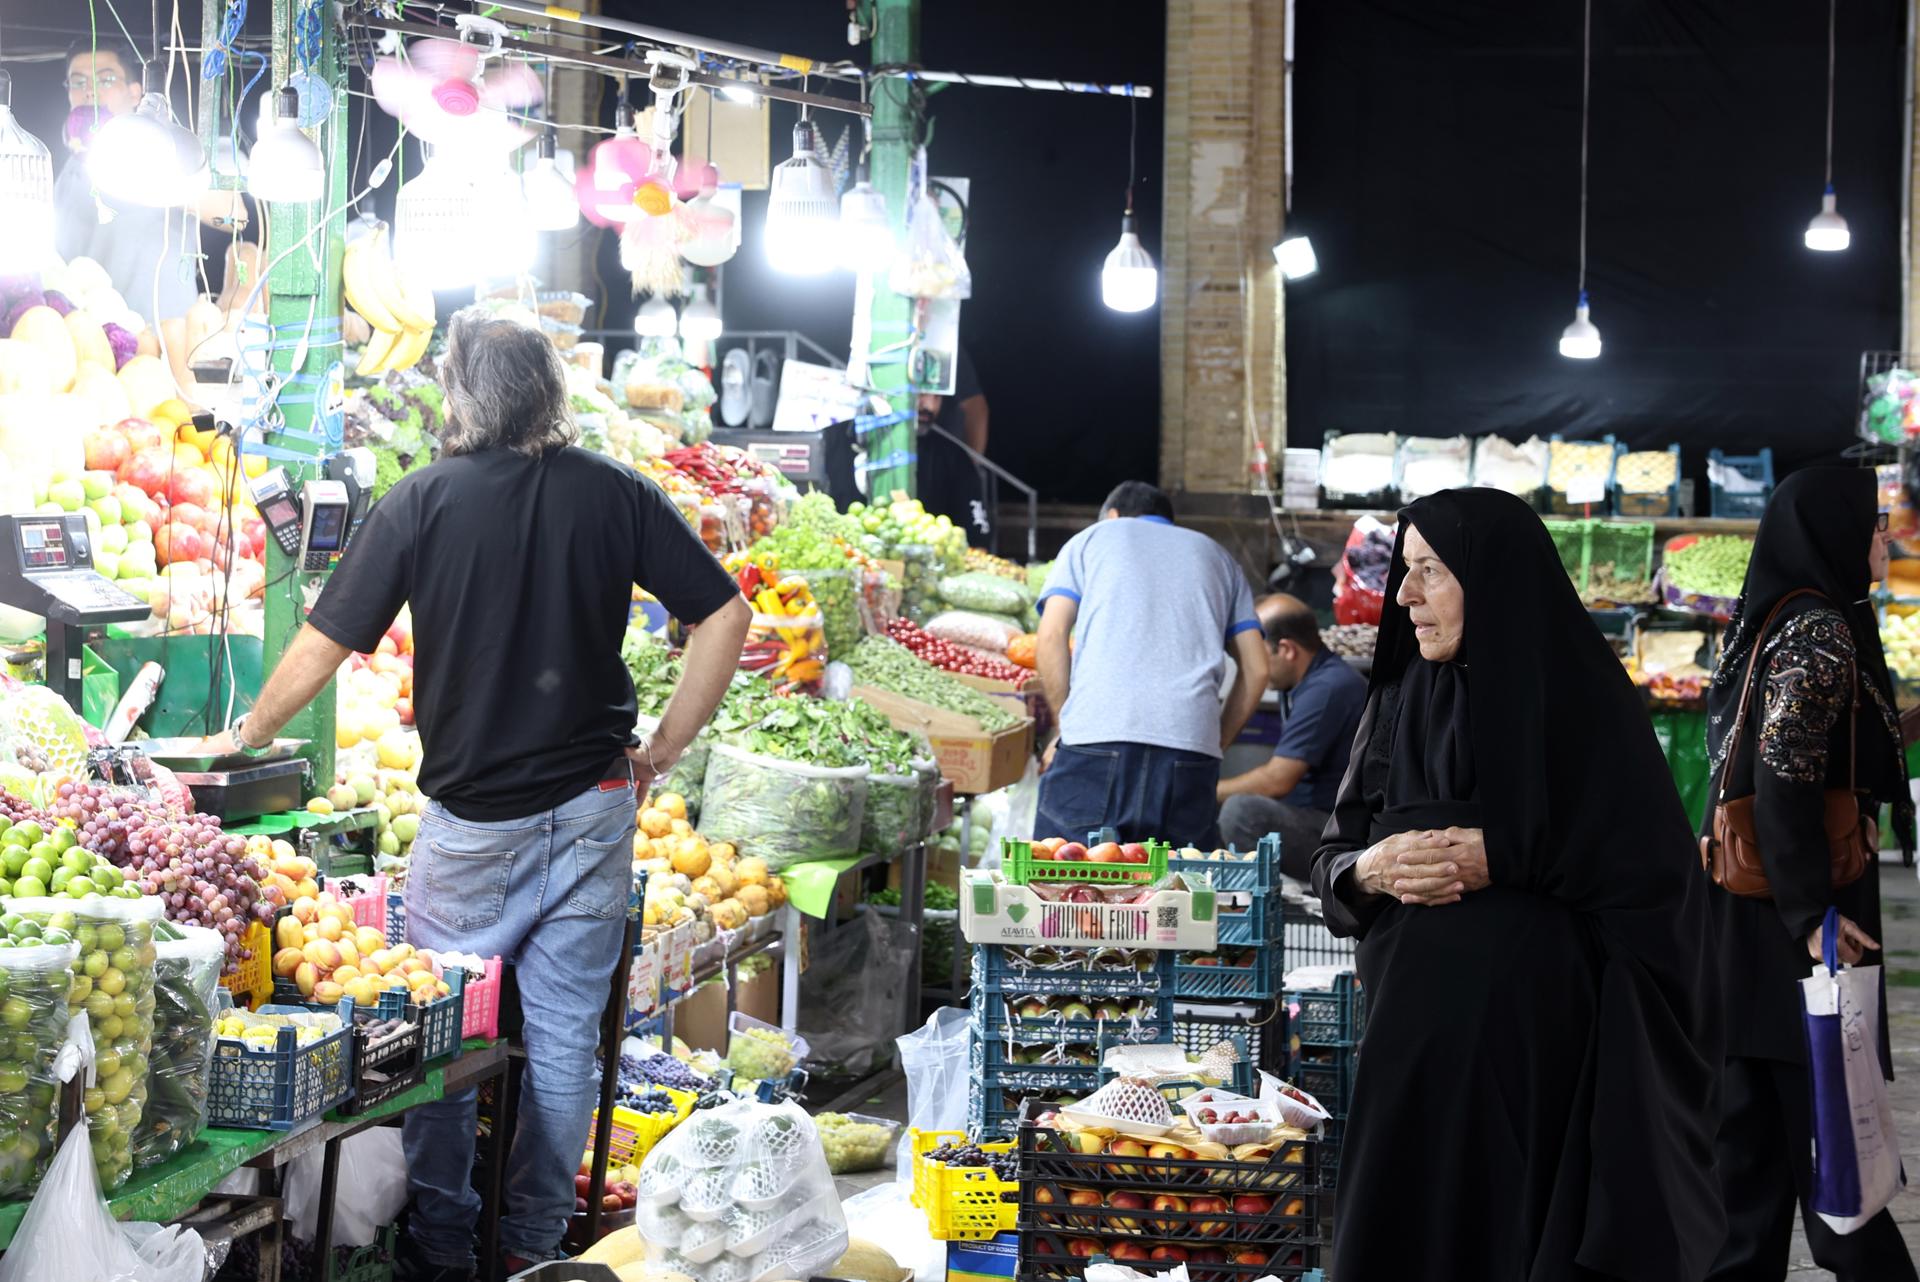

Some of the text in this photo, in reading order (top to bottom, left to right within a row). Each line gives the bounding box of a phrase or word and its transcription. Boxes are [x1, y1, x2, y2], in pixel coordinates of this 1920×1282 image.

[1040, 904, 1150, 941] TROPICAL FRUIT
[1001, 927, 1035, 936] ATAVITA
[996, 1246, 1018, 1254] ECUADO
